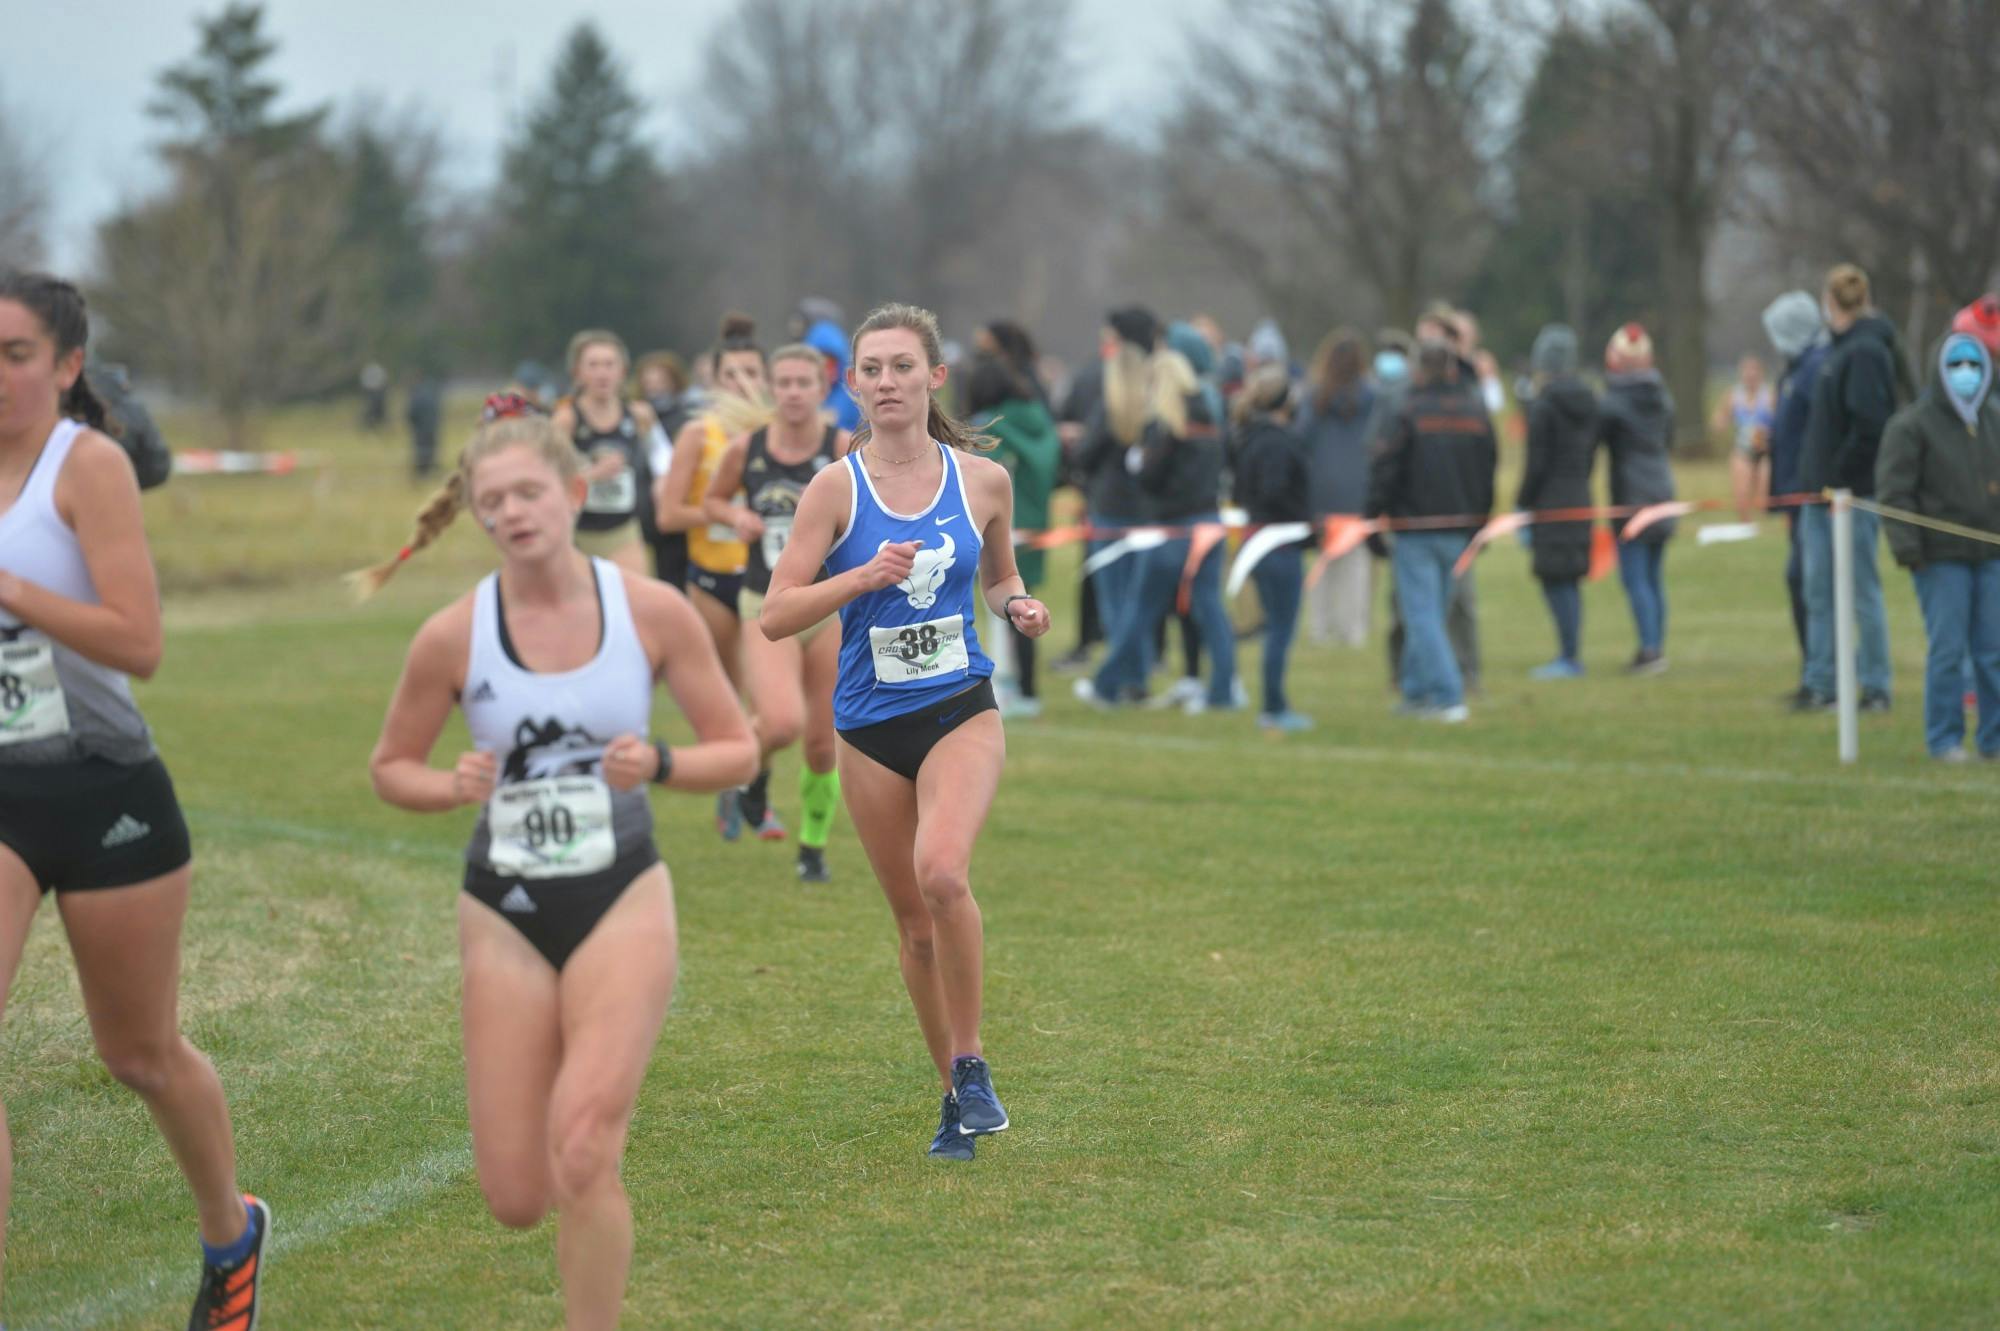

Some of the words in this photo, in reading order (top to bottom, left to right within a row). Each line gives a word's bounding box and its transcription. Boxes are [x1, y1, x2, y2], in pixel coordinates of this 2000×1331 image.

[899, 625, 938, 660] 38
[906, 667, 919, 676] Lily
[525, 806, 574, 847] 90
